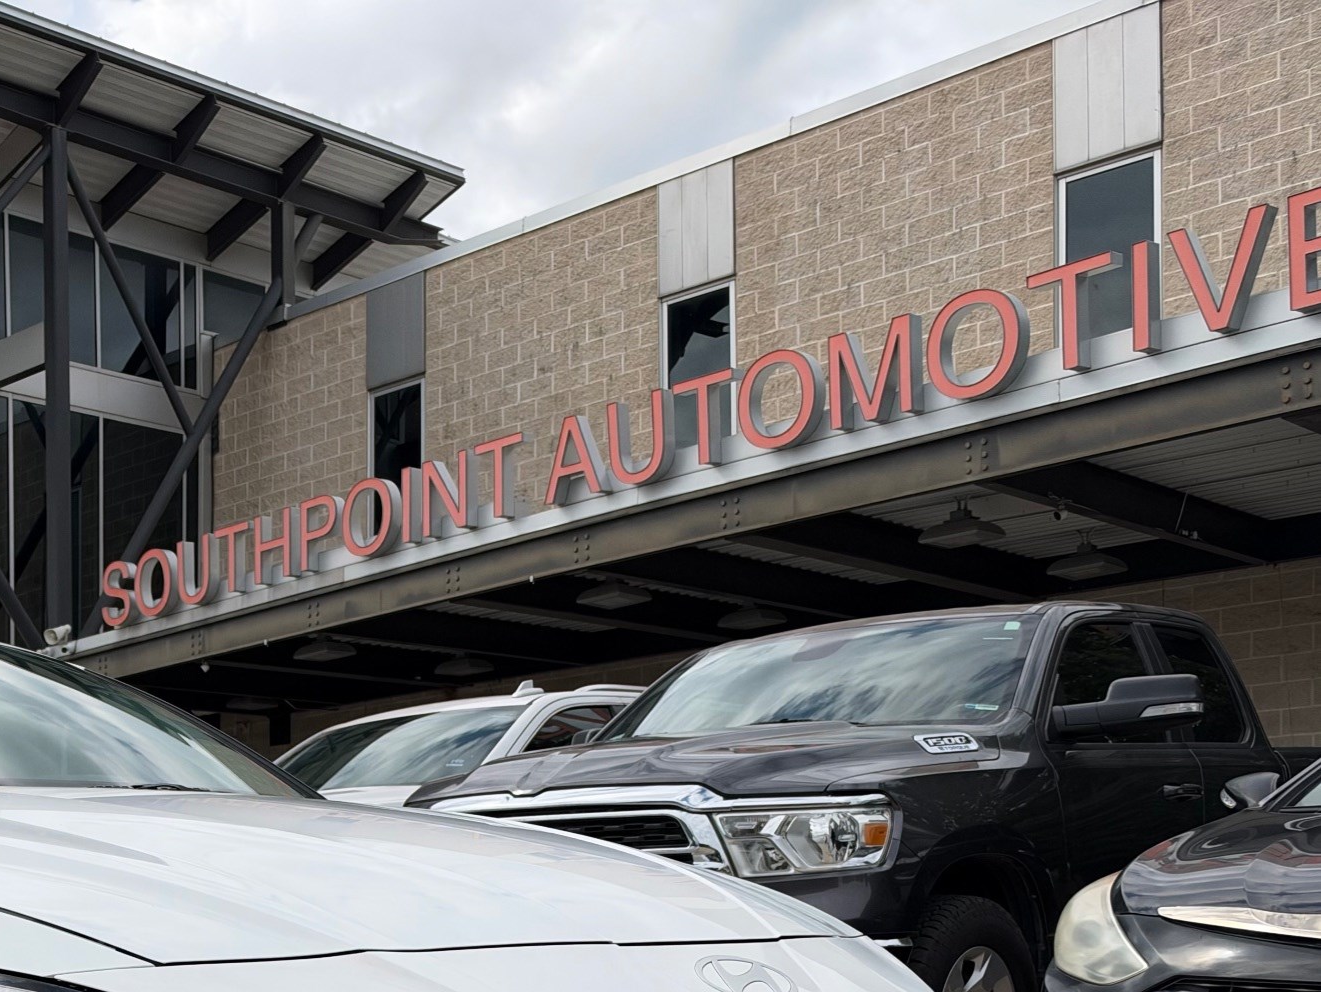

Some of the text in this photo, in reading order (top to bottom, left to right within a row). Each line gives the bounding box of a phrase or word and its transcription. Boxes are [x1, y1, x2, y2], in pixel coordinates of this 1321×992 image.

[101, 186, 1321, 627] SOUTHPOINT AUTOMOTIVE
[925, 736, 967, 747] 1500
